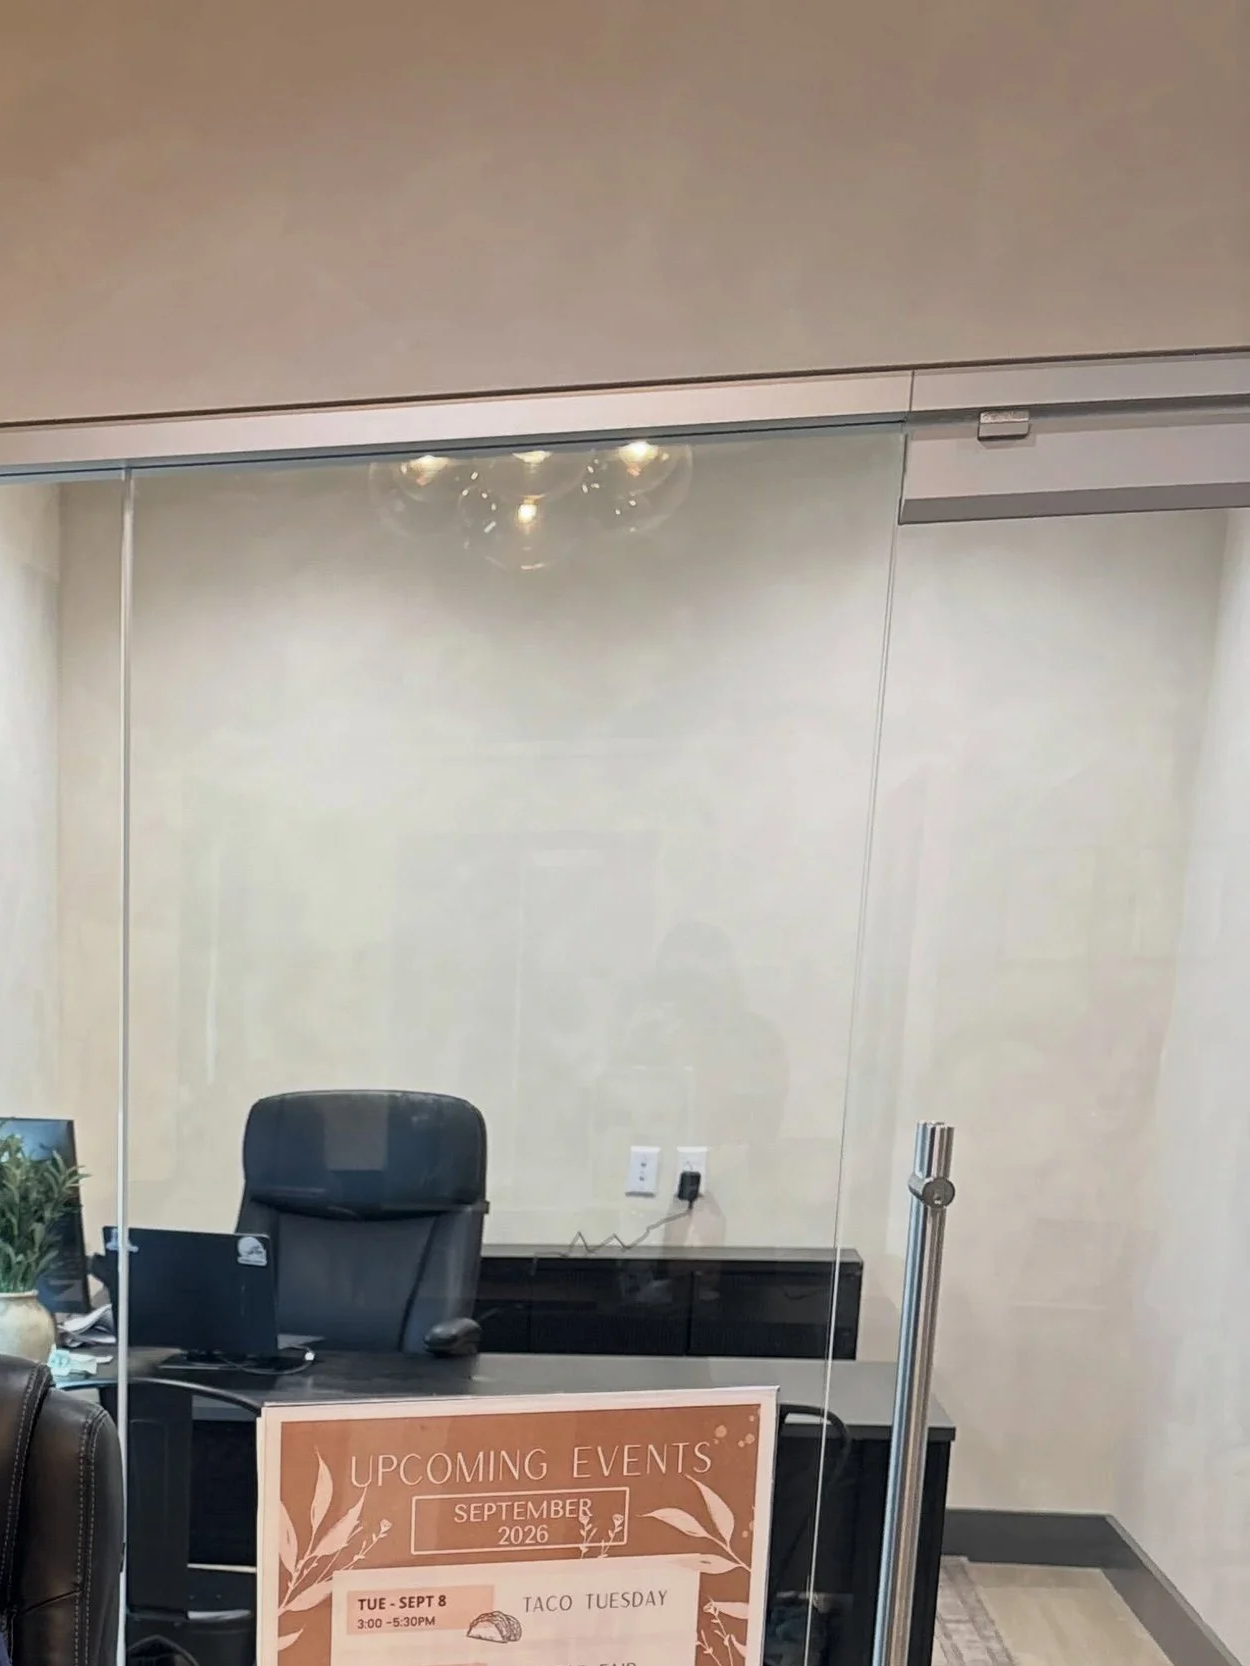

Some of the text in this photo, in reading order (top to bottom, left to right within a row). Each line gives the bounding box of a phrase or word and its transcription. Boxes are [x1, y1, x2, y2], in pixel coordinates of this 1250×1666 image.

[351, 1441, 712, 1488] UPCOMING EVENTS
[453, 1498, 593, 1524] SEPTEMBER
[497, 1525, 549, 1546] 2026
[357, 1597, 387, 1611] TUE
[398, 1595, 435, 1609] SEPT
[437, 1594, 447, 1607] 8
[523, 1590, 668, 1613] TACO TUESDAY
[357, 1618, 383, 1630] 3:00
